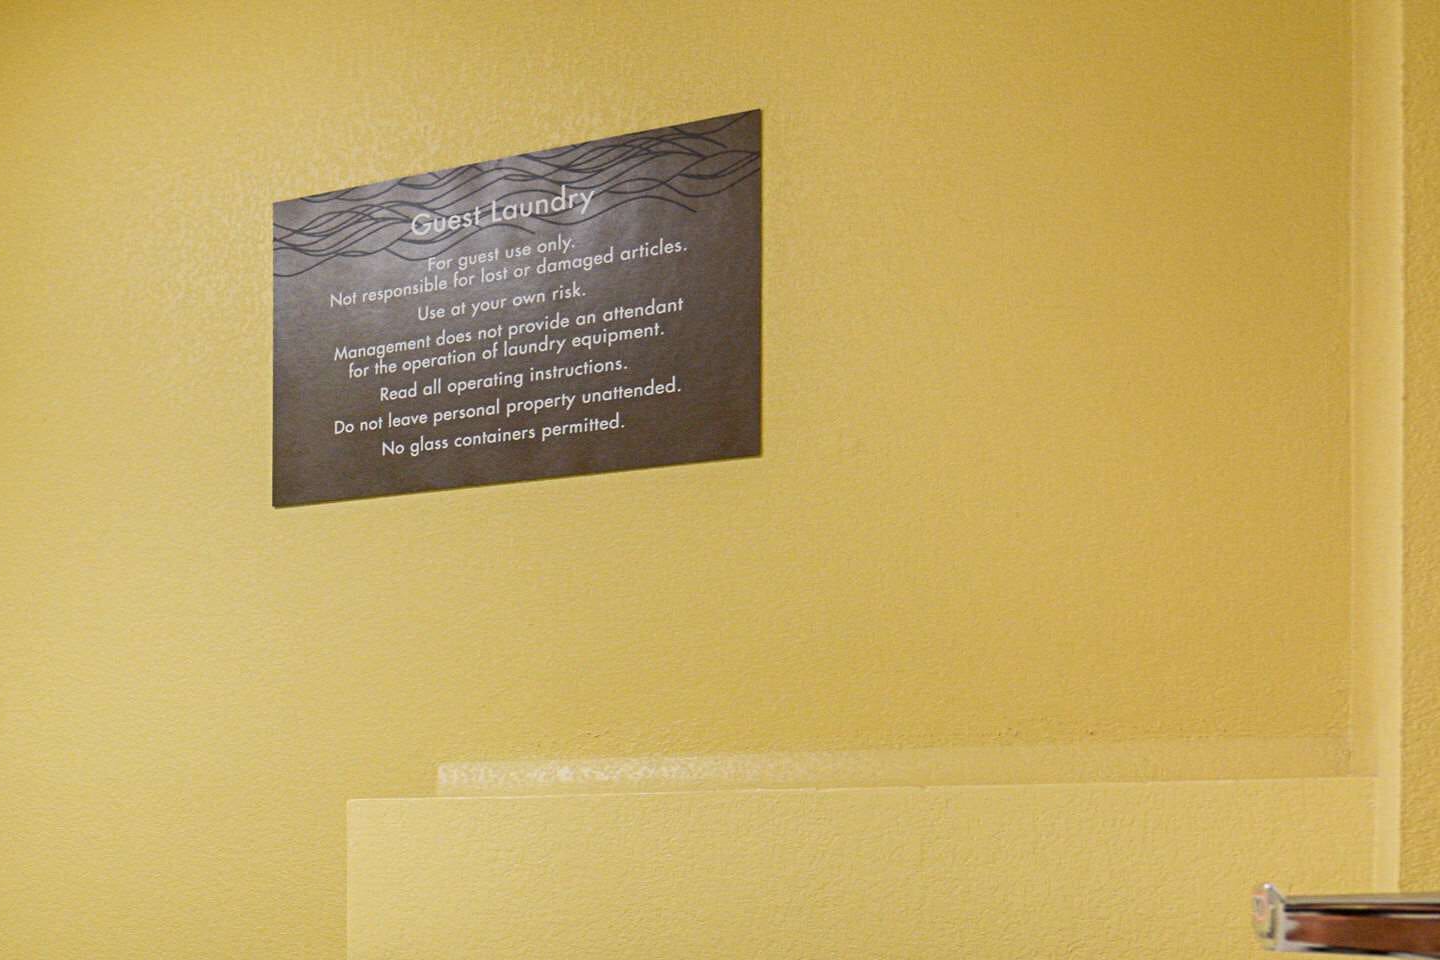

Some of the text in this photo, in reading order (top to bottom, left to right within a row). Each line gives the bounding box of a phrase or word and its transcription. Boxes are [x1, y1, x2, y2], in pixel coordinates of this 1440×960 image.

[411, 184, 595, 236] Guest Laundry
[330, 238, 687, 308] Not responsible for lost or damaged articles.
[428, 234, 575, 272] For guest use only.
[418, 281, 586, 321] Use at your own risk.
[334, 298, 684, 361] Management does not provide an attendant
[349, 323, 664, 379] for the operation of laundry equipment.
[334, 375, 681, 435] Do not leave personal property unattended.
[380, 359, 627, 401] Read all operating instructions.
[382, 412, 625, 457] No glass containers permitted.
